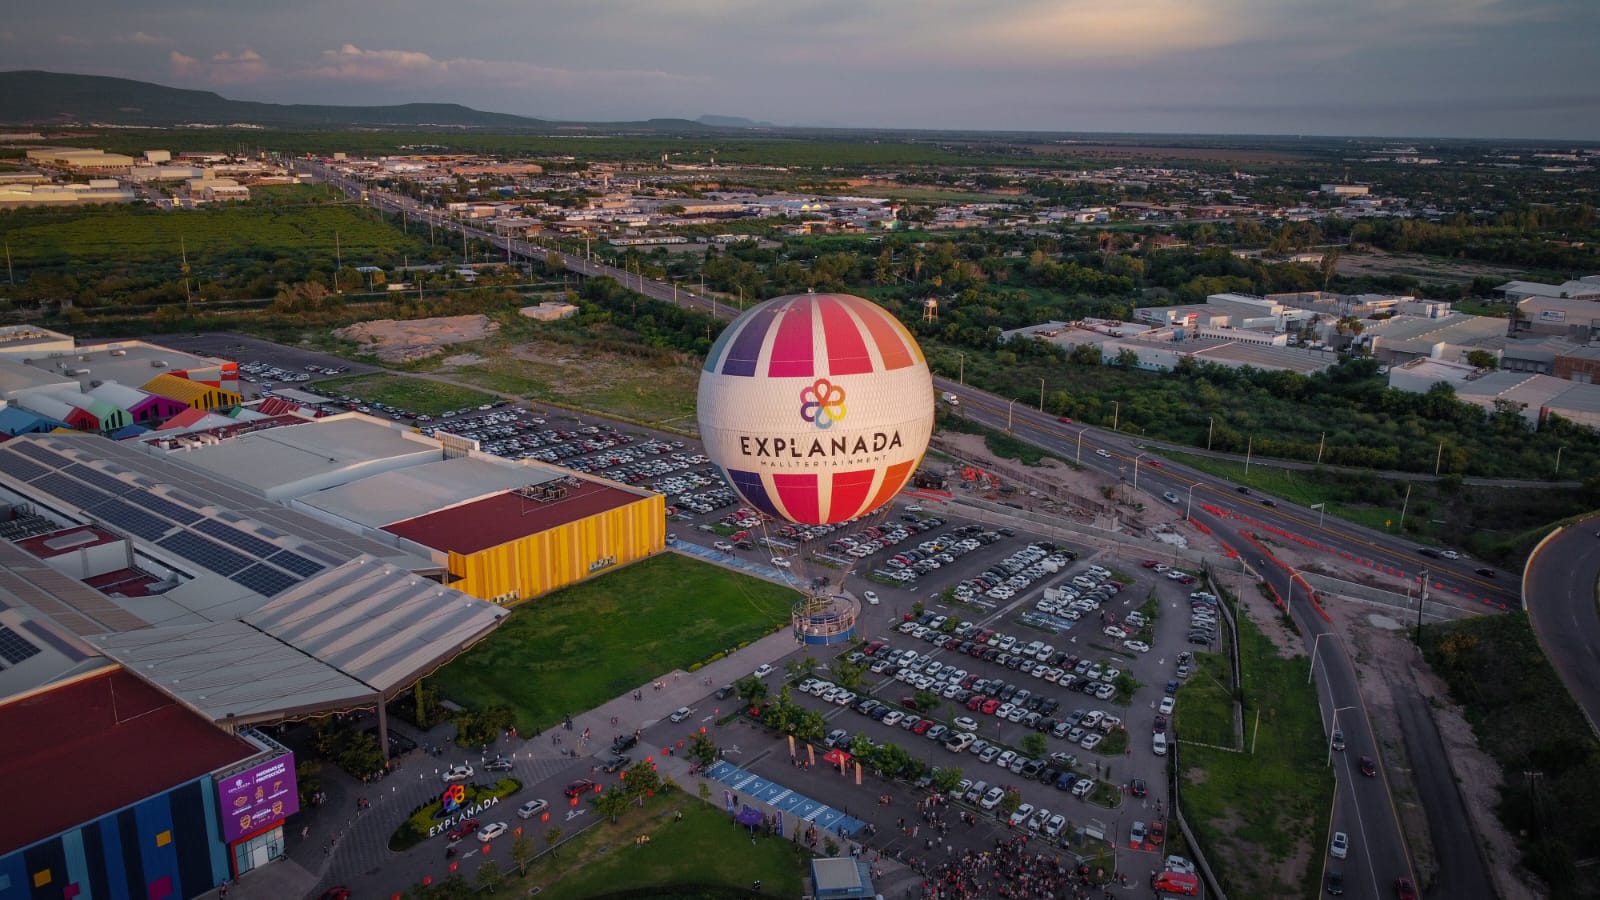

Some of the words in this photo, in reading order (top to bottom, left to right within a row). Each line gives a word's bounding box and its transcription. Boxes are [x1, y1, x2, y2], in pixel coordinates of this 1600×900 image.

[740, 430, 902, 457] EXPLANADA
[760, 455, 887, 468] MALLTERTAINMENT
[429, 796, 499, 838] EXPLANADA
